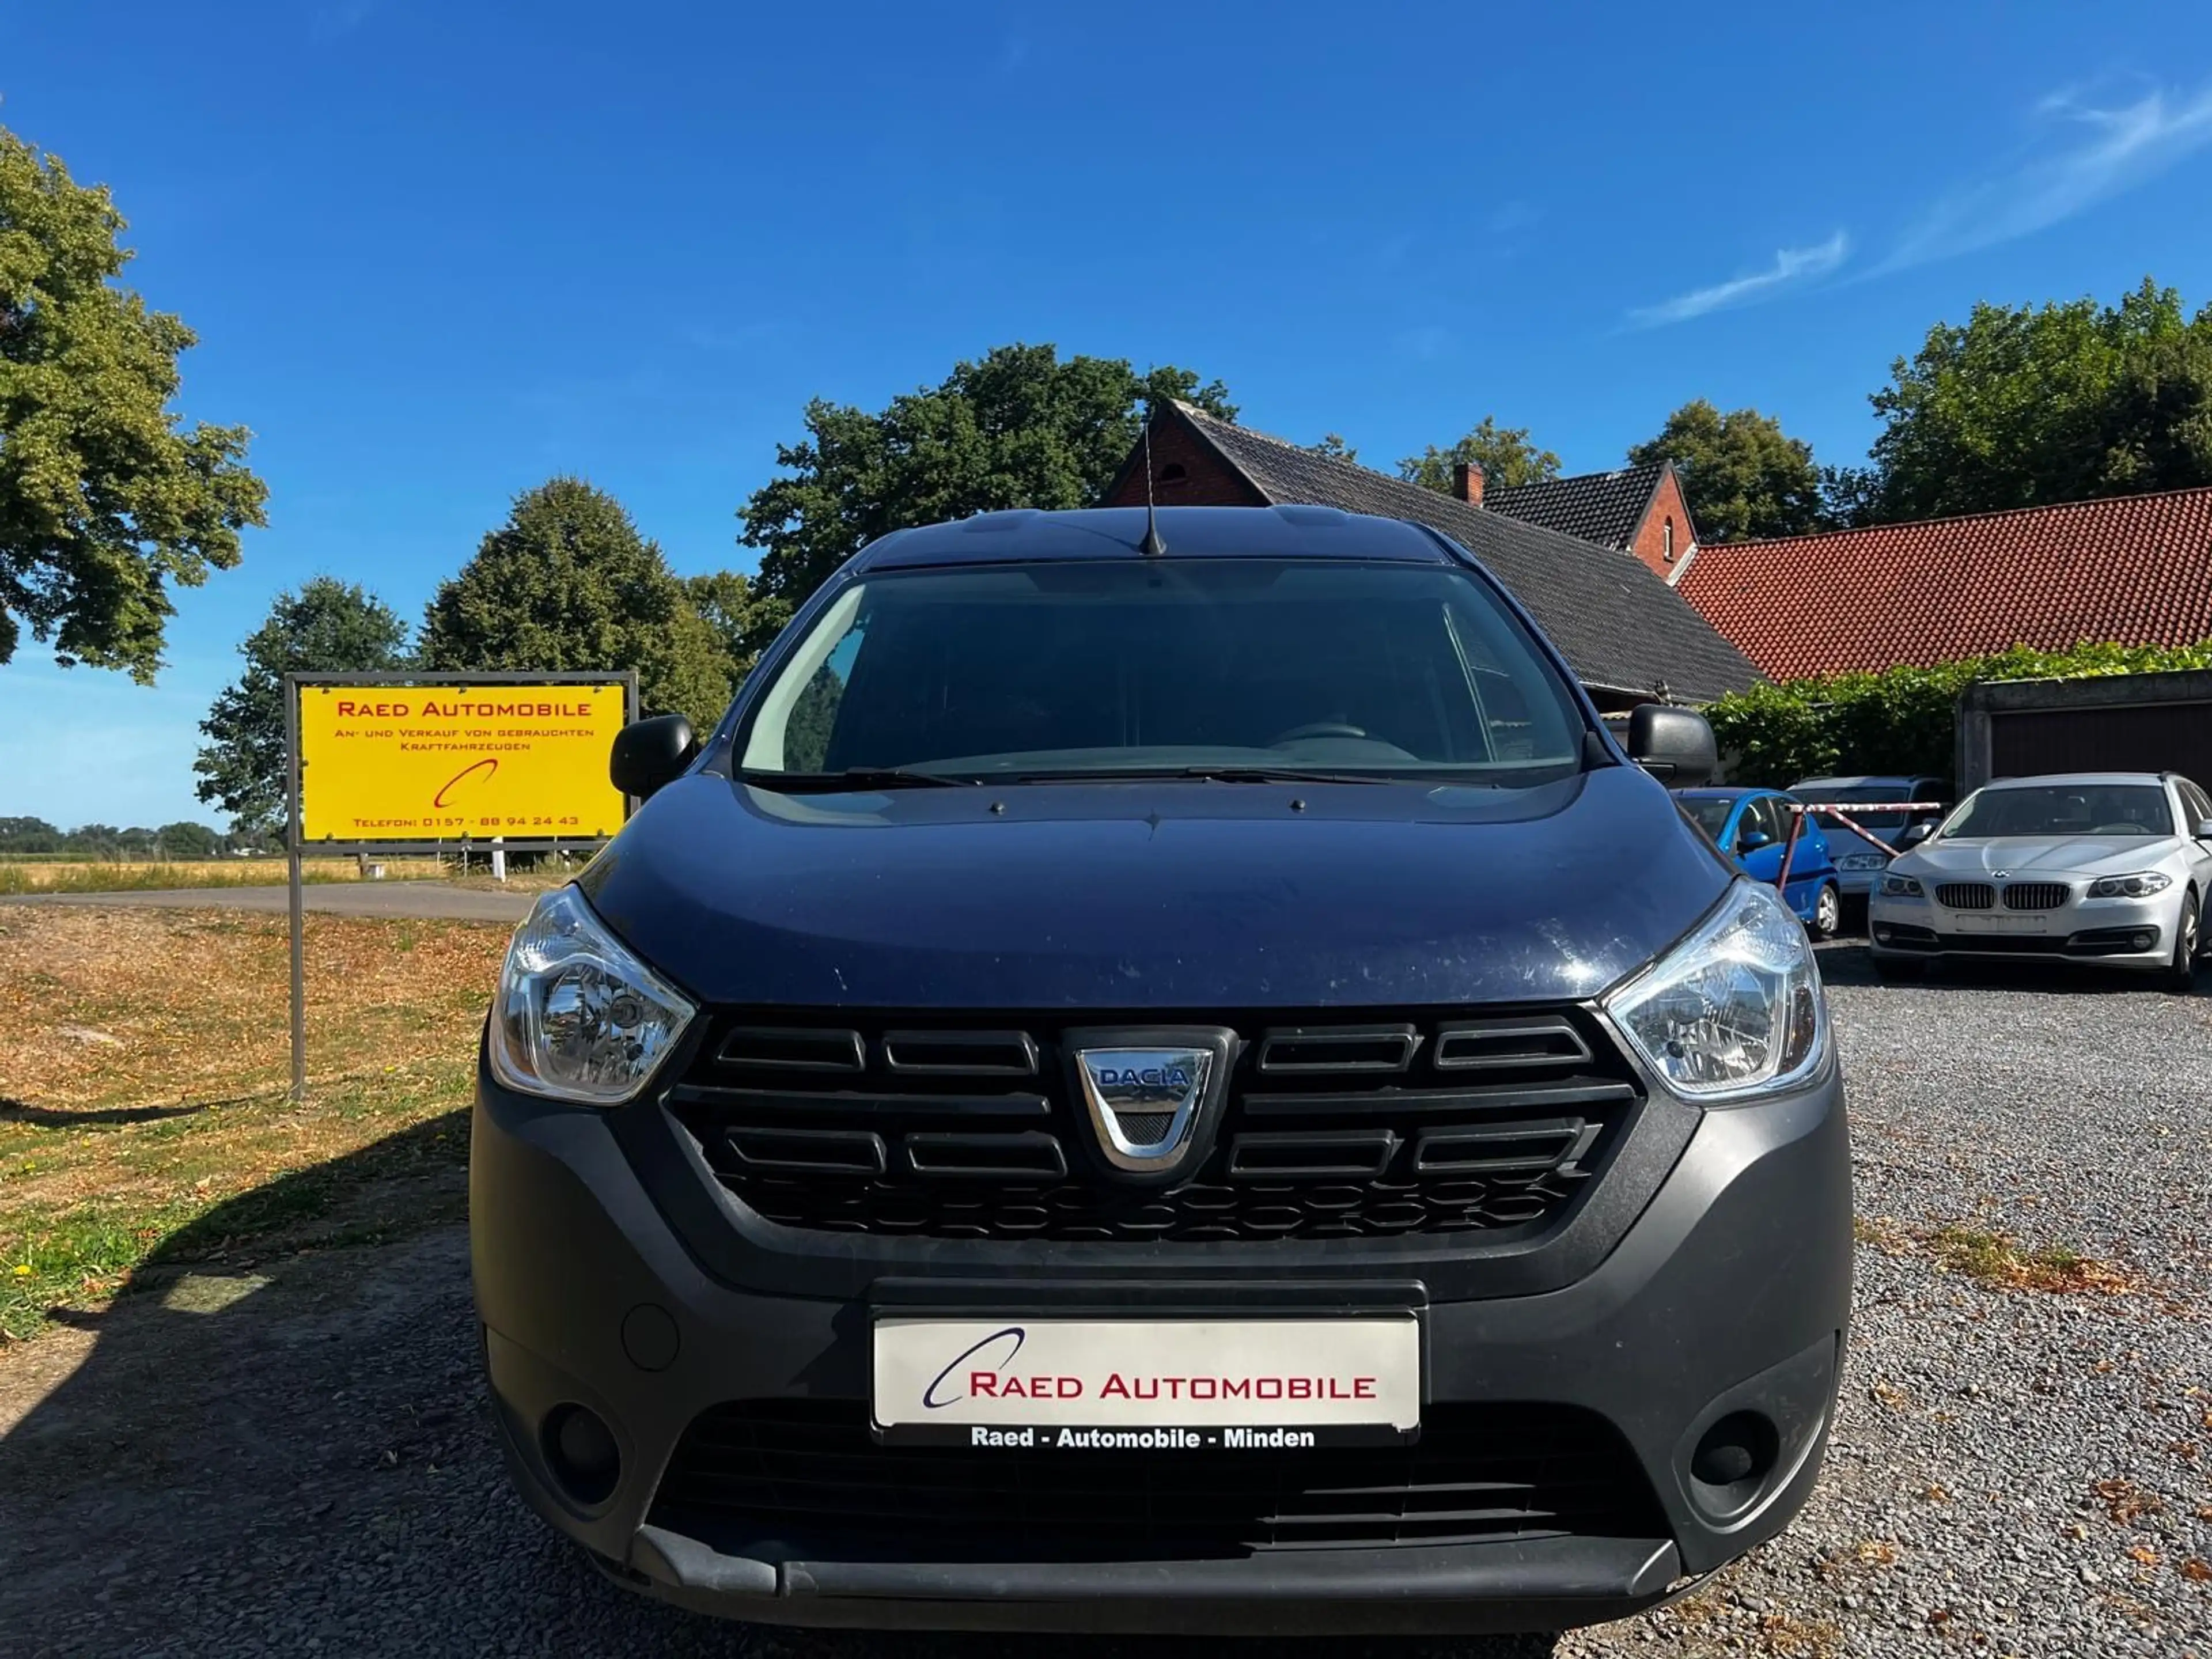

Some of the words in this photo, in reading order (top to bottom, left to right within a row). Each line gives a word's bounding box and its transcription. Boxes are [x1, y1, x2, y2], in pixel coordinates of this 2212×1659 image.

[338, 701, 410, 717] RAED
[421, 701, 592, 717] AUTOMOBILE
[422, 817, 464, 828] 0157
[480, 817, 500, 826] 88
[507, 817, 527, 827] 94
[533, 816, 552, 825] 24
[559, 816, 579, 825] 43
[1099, 1069, 1189, 1085] DACIA
[969, 1371, 1084, 1400] RAED
[1099, 1372, 1376, 1400] AUTOMOBILE
[972, 1426, 1034, 1447] Raed
[1056, 1428, 1201, 1448] Automobile
[1224, 1428, 1315, 1448] Minden
